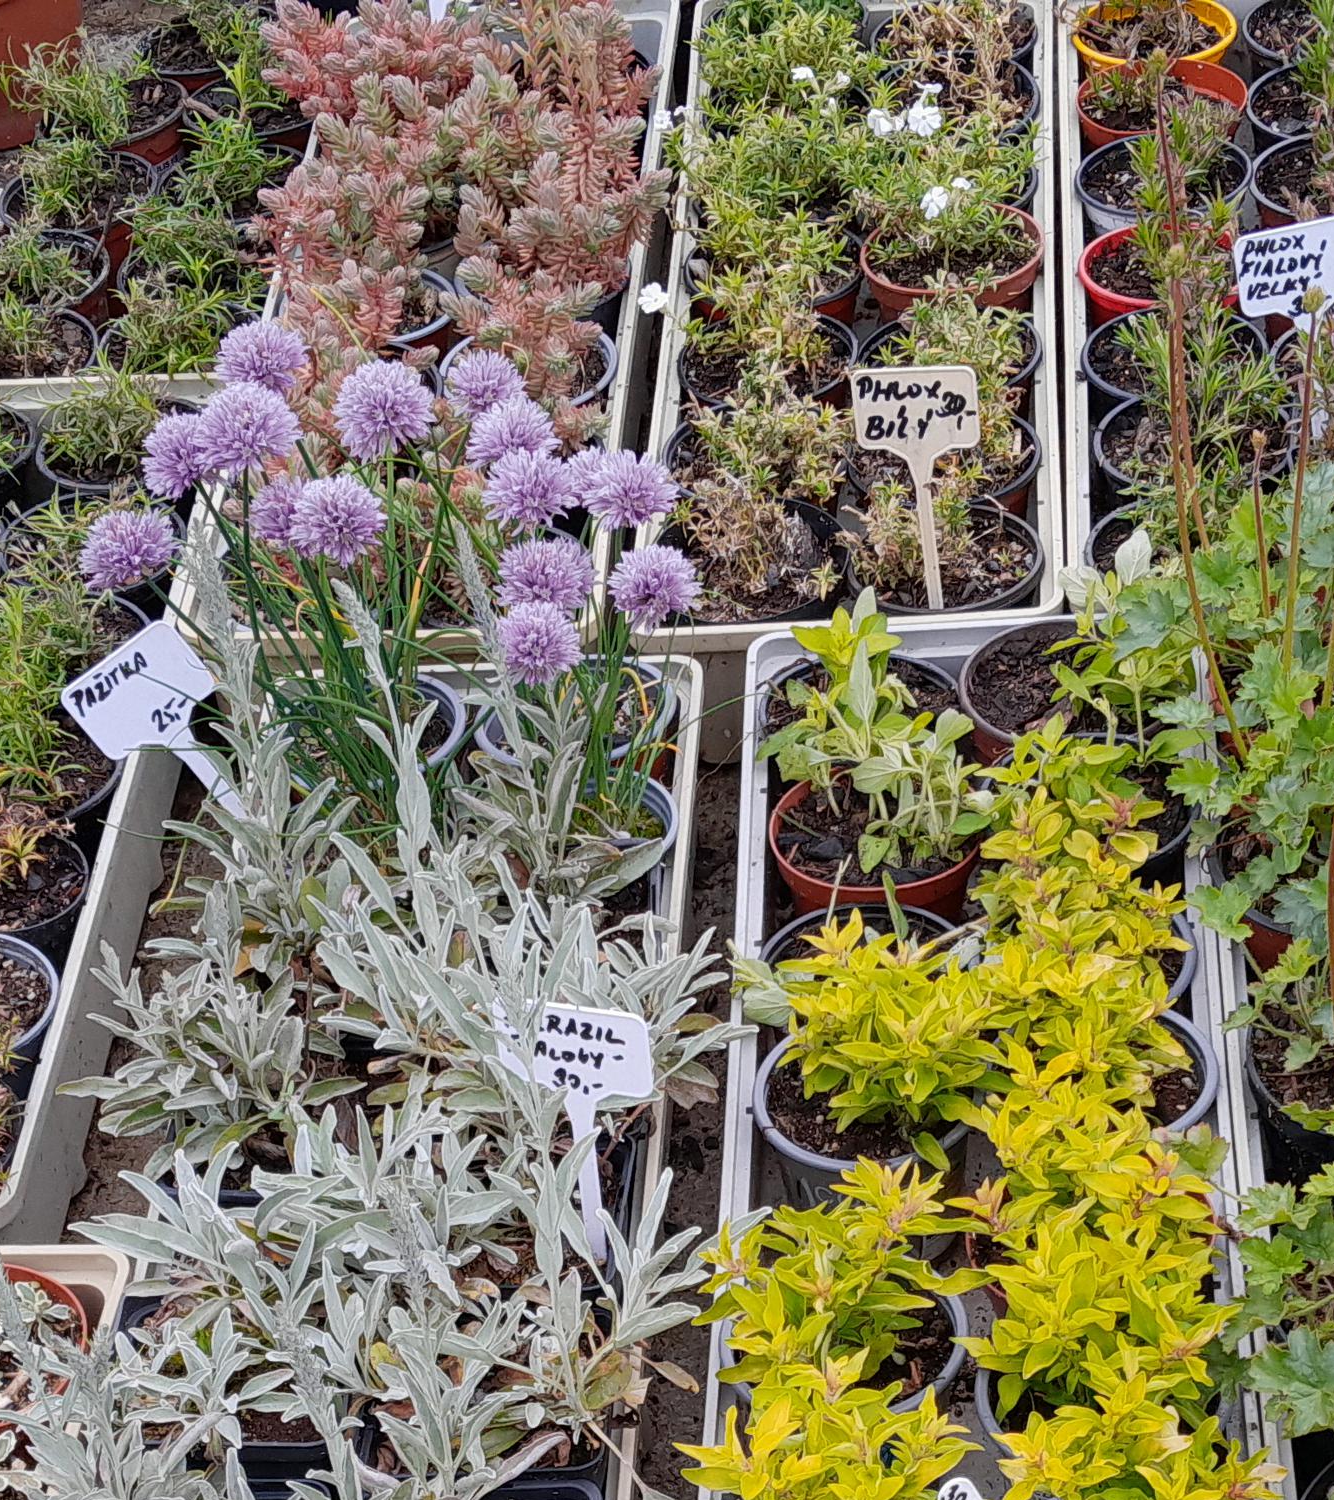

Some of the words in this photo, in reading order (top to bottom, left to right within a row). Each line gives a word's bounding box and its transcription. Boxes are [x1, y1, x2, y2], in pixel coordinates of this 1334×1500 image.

[856, 375, 942, 402] PHLOX
[69, 651, 148, 718] PAŽITKA
[504, 1014, 626, 1045] RAZIL
